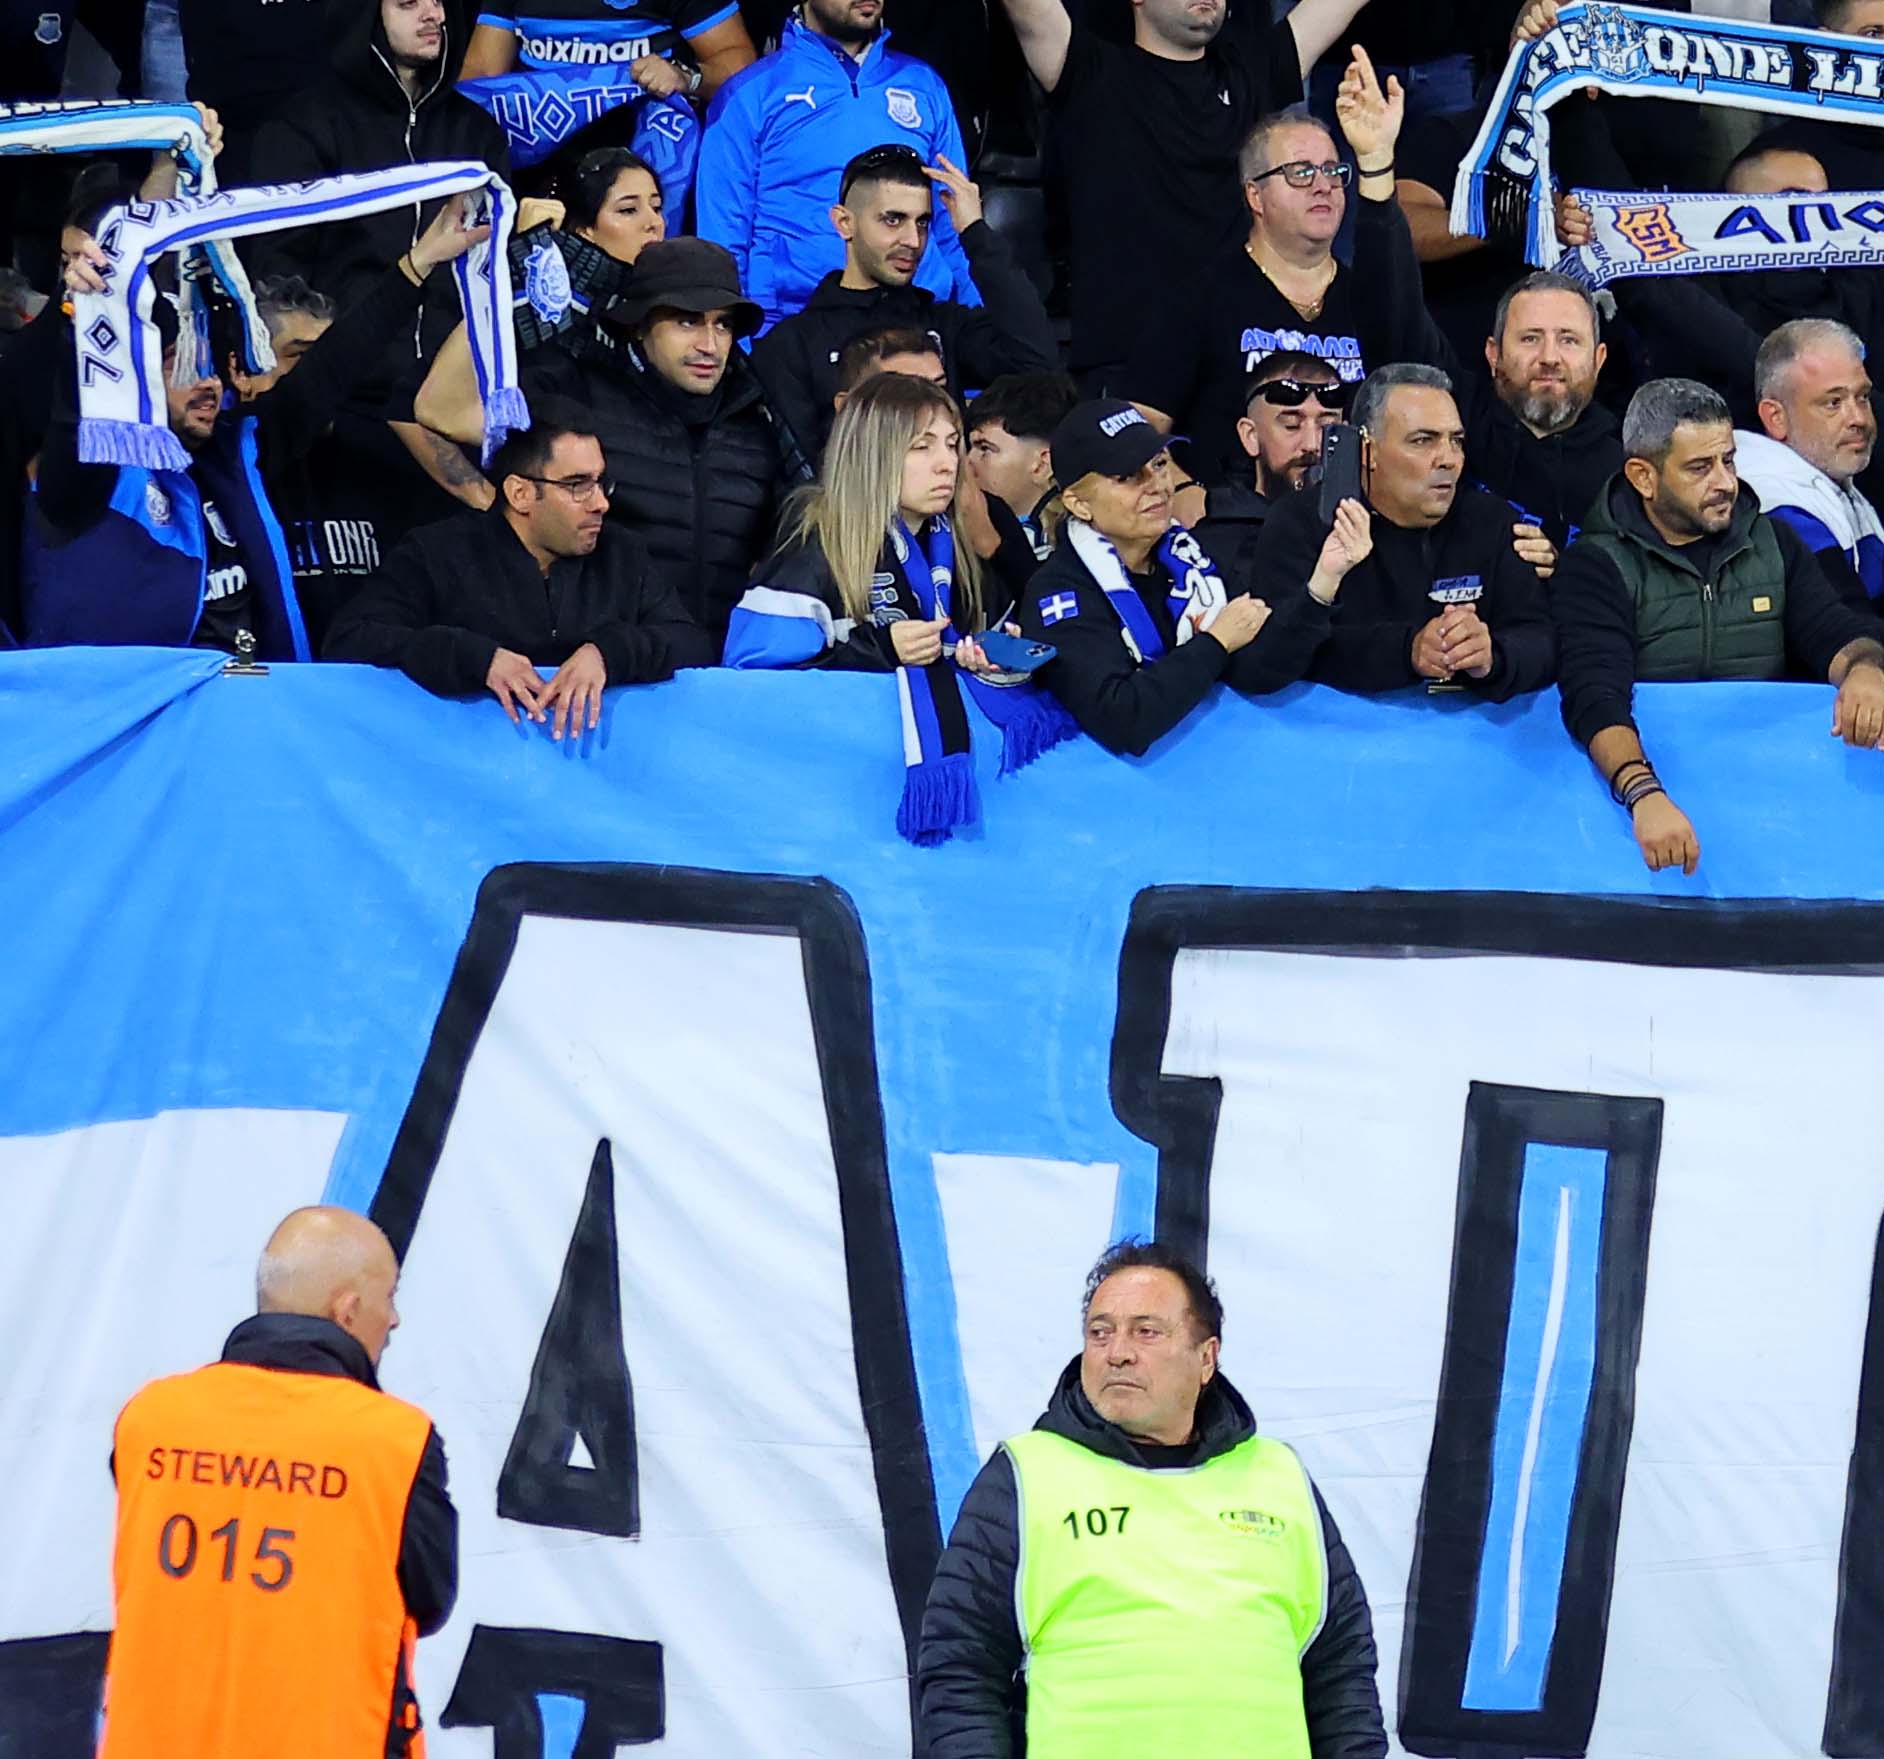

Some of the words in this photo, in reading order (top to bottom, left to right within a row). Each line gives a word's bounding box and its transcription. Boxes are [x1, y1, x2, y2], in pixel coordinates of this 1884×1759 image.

[1645, 25, 1794, 90] ONE
[145, 1444, 350, 1501] STEWARD
[156, 1510, 298, 1593] 015
[1060, 1504, 1135, 1542] 107
